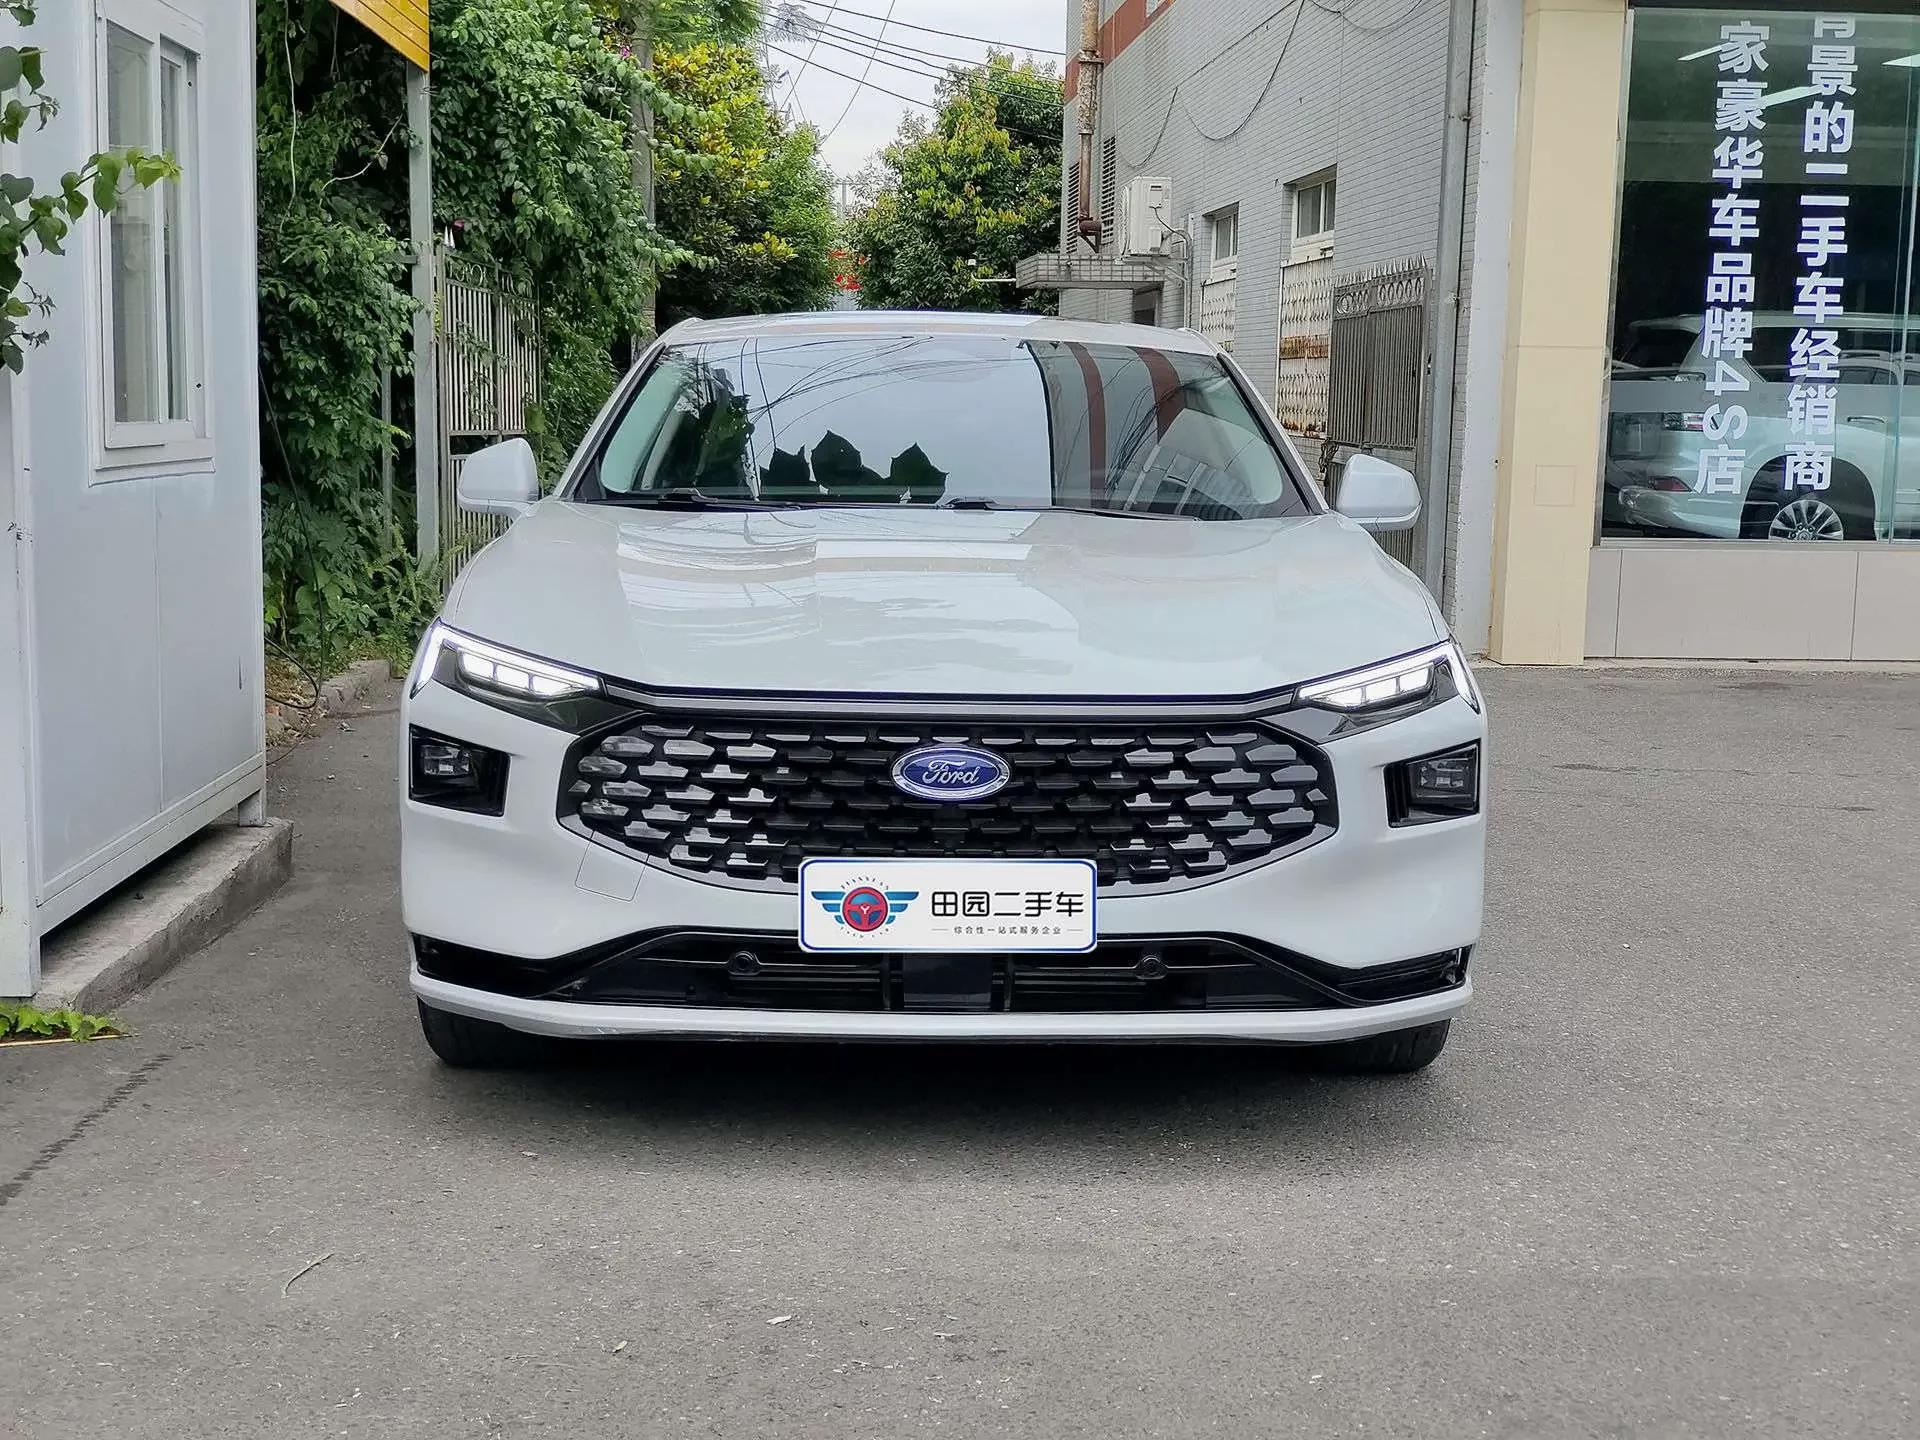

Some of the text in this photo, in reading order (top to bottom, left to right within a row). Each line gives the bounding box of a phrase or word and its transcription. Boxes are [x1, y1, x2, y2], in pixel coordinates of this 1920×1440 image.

[1693, 20, 1770, 495] 家豪华车品牌4S店
[922, 759, 981, 784] Ford
[931, 891, 1085, 918] 田园二手车
